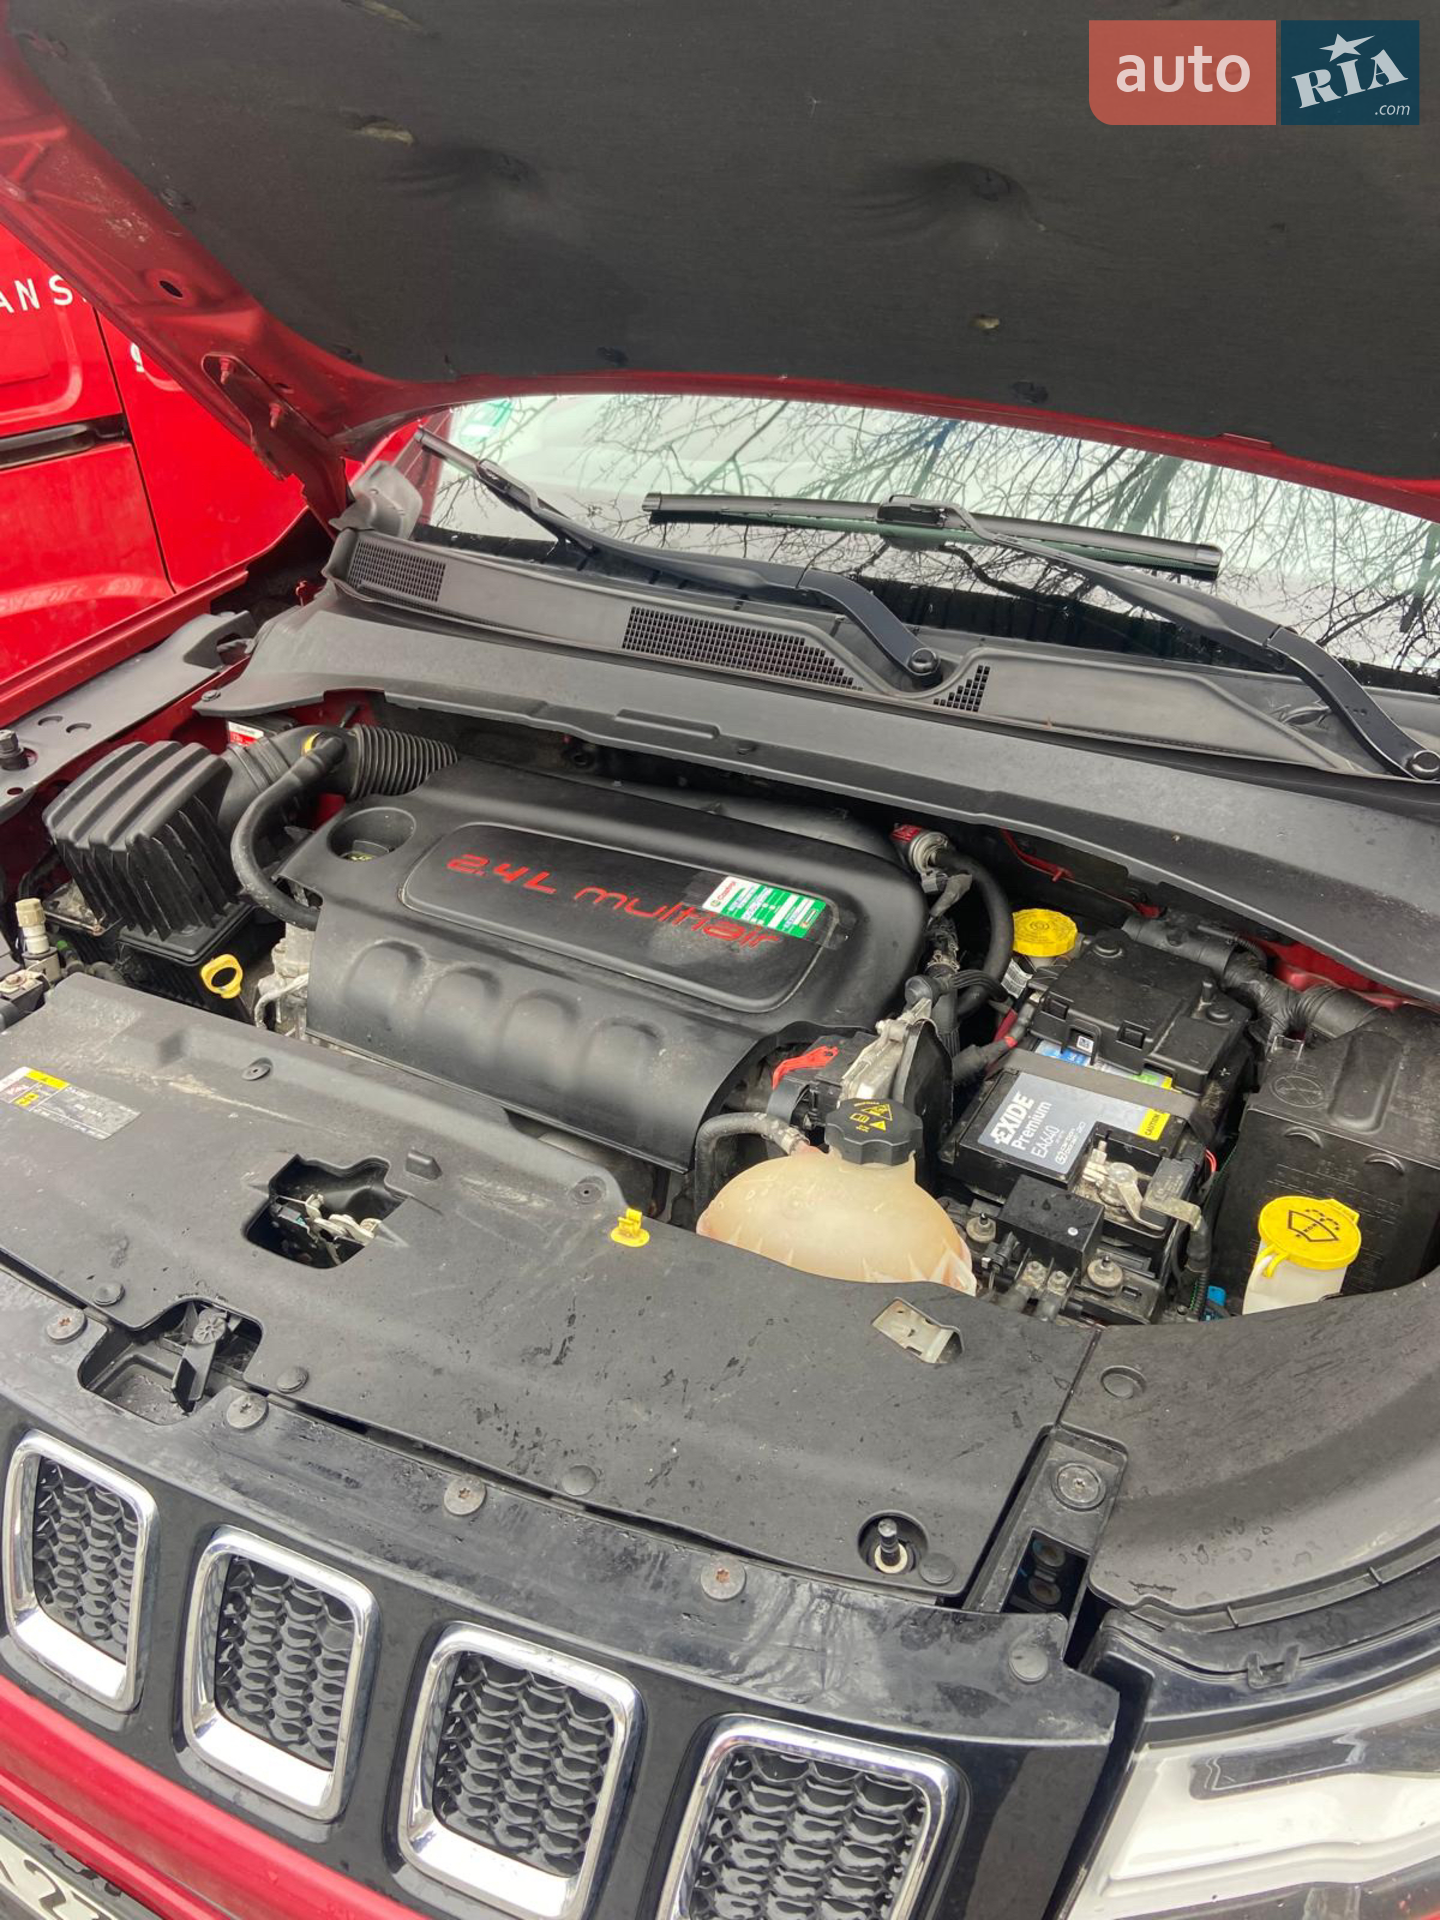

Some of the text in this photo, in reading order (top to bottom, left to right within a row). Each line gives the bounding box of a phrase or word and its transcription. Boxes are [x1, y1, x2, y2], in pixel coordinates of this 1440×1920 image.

[446, 853, 557, 894] 2.4L
[574, 886, 779, 948] multiair
[990, 1091, 1034, 1145] EXIDE
[1011, 1101, 1053, 1151] Premium
[1030, 1124, 1060, 1159] EA640
